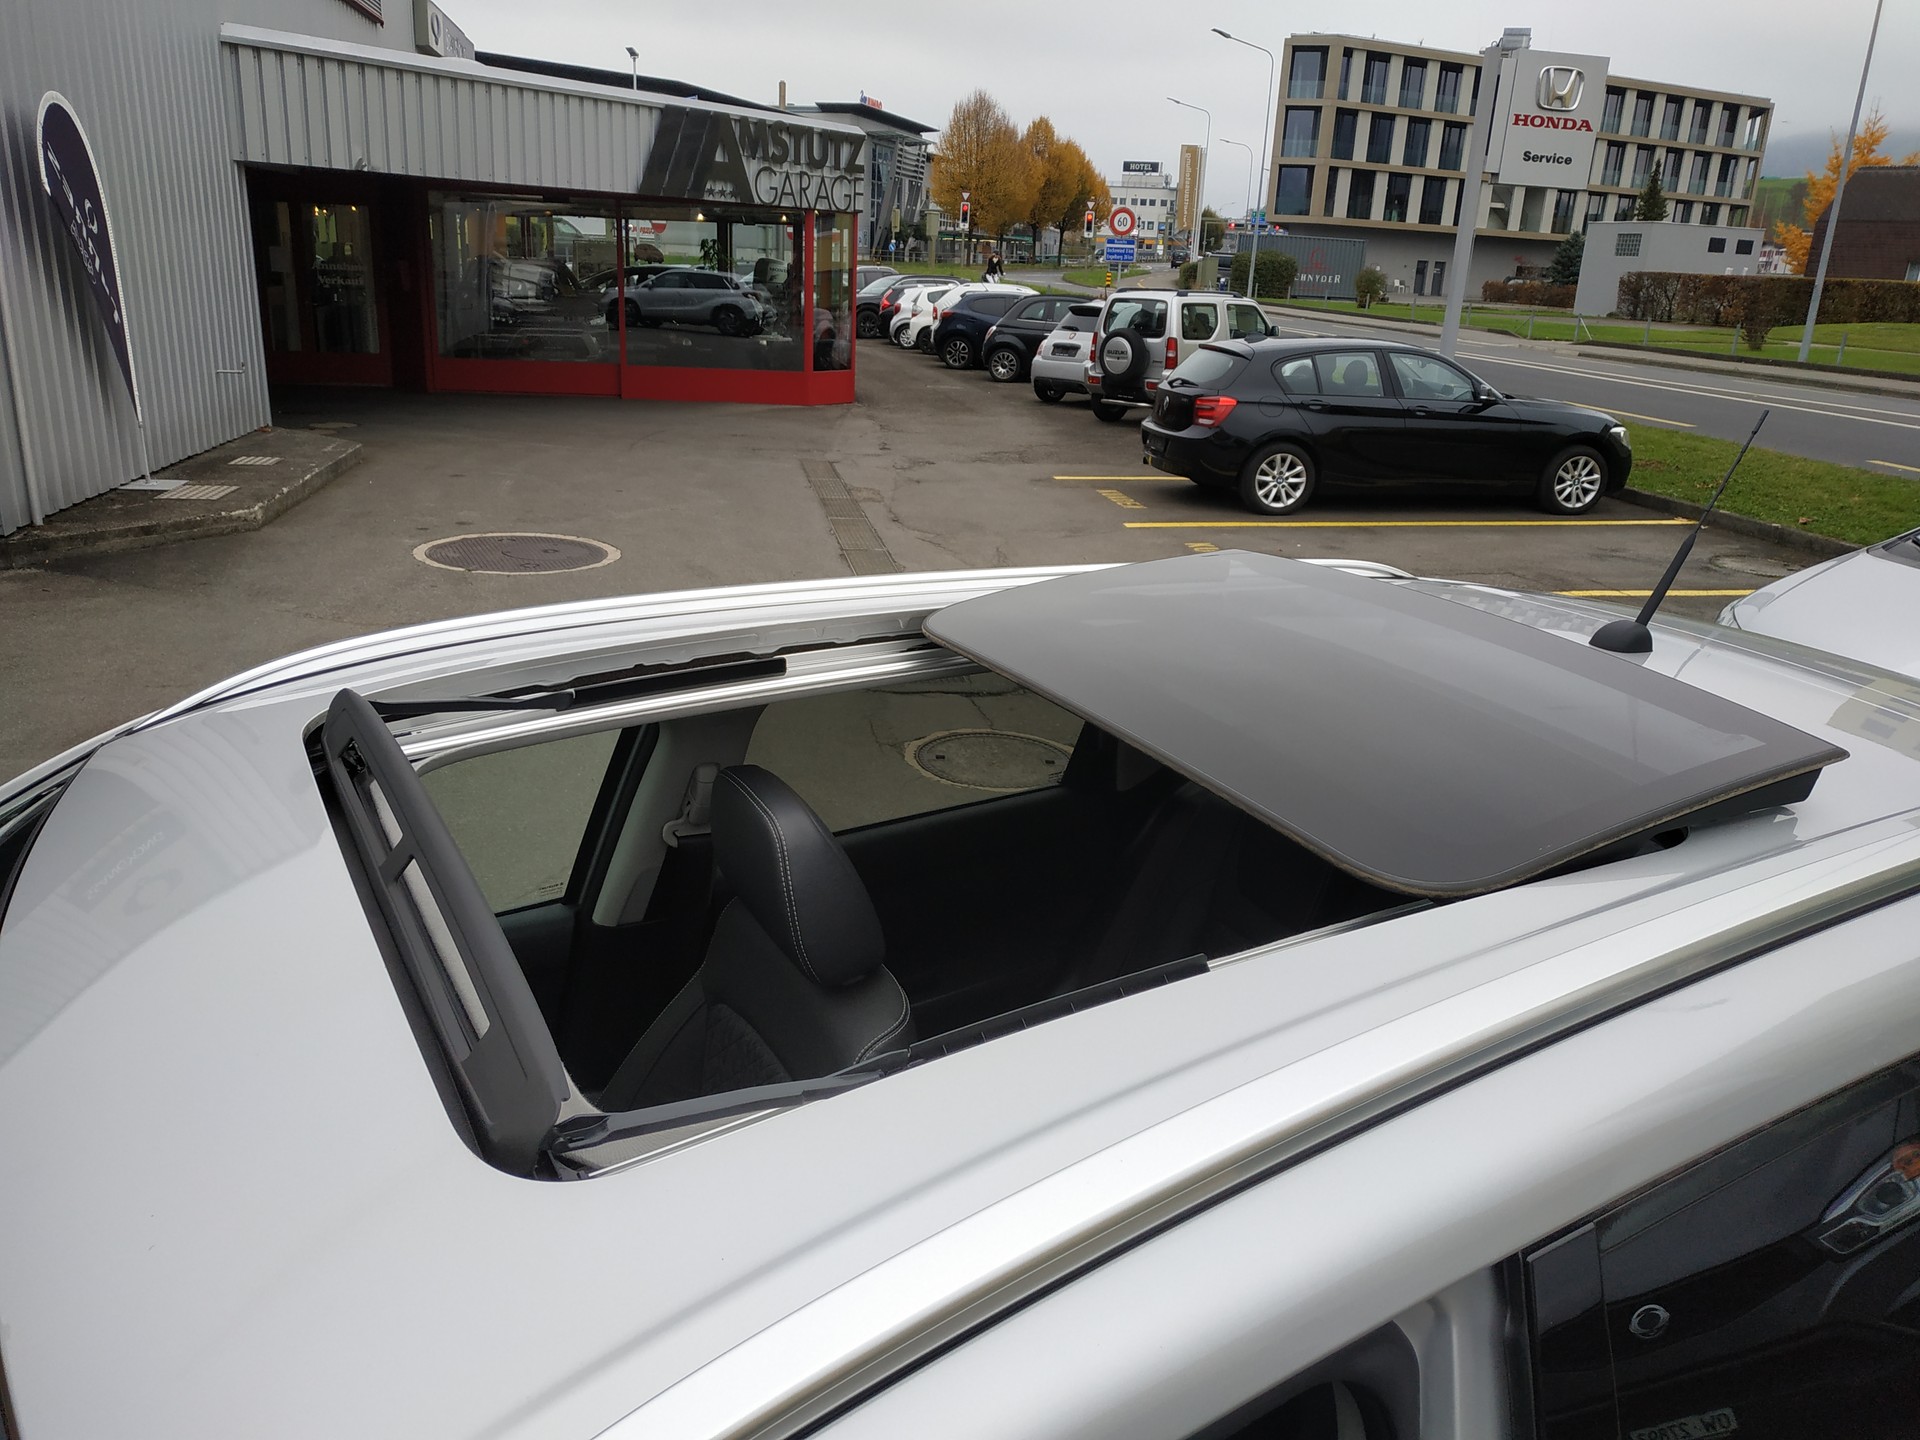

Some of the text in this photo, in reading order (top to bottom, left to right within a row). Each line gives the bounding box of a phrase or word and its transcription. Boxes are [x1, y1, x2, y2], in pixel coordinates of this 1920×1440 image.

[1512, 113, 1594, 132] HONDA
[686, 112, 867, 204] AMSTUTZ
[1522, 150, 1573, 165] Service
[754, 165, 865, 213] GARAGE
[1117, 216, 1128, 227] 60
[1294, 273, 1341, 284] CHNYDER
